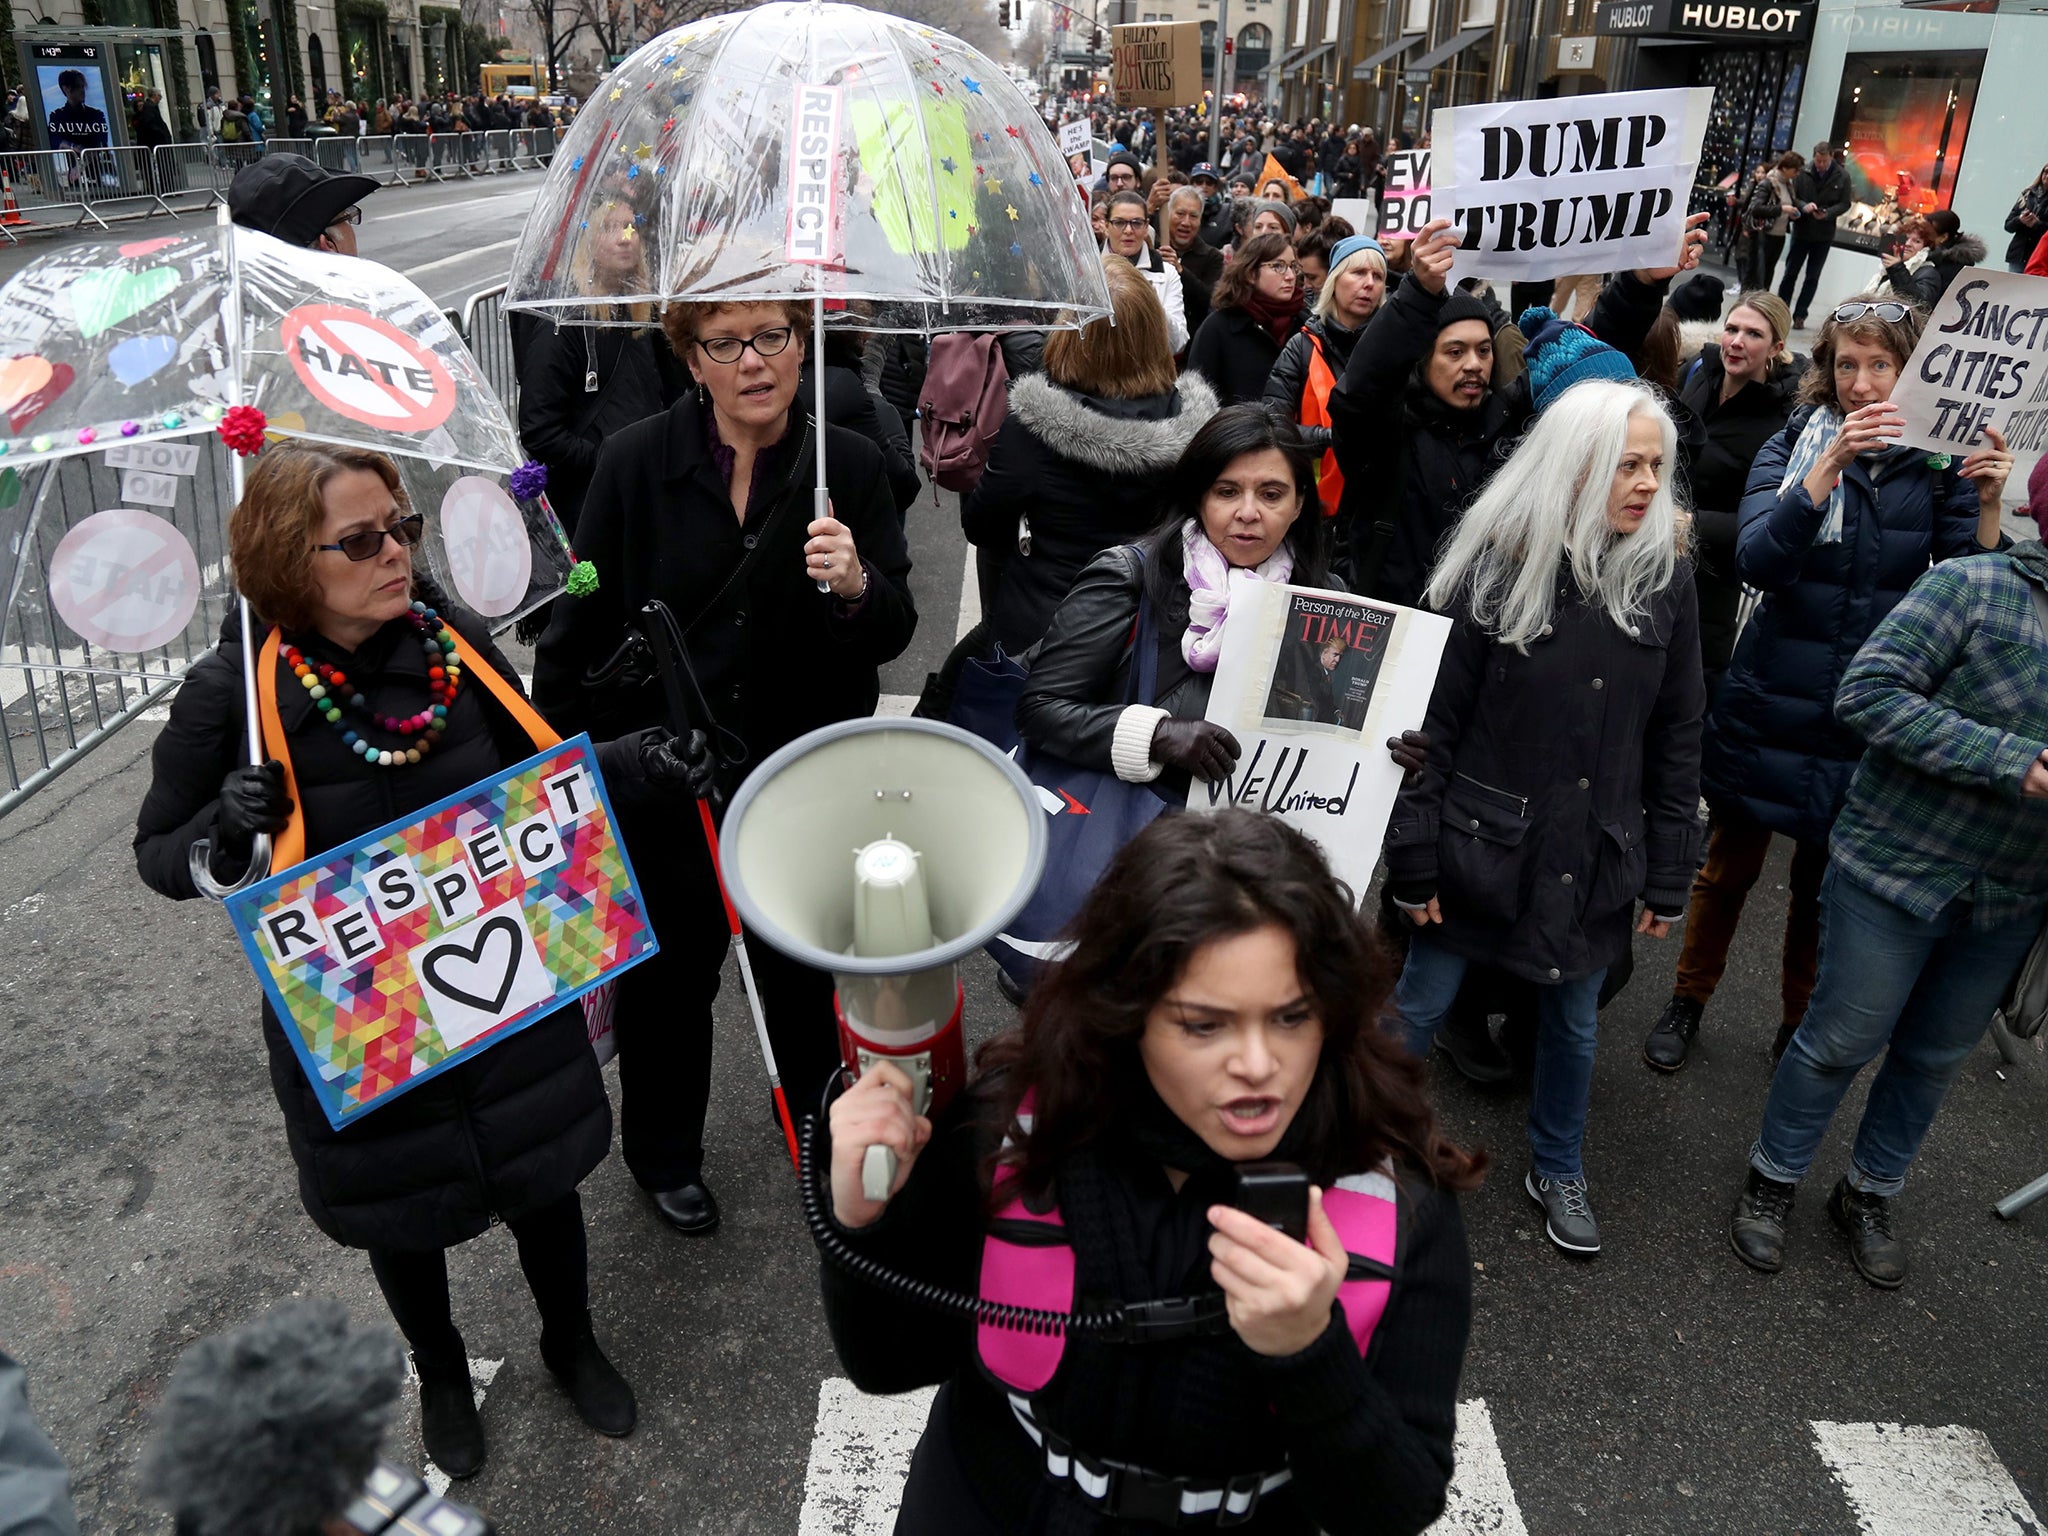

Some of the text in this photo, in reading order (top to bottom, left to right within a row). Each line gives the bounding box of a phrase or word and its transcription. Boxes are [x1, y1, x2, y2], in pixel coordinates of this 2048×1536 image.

[1609, 5, 1653, 29] HUBLOT
[1682, 4, 1801, 32] HUBLOT
[1137, 61, 1171, 91] VOTES
[49, 122, 109, 133] SAUVAGE
[1480, 115, 1667, 182] DUMP
[795, 92, 833, 256] RESPECT
[1454, 187, 1674, 252] TRUMP
[1939, 280, 2048, 353] SANCT
[296, 335, 439, 394] HATE
[1919, 343, 2031, 400] CITIES
[1928, 397, 1996, 447] THE
[1294, 597, 1390, 626] Person of the Year
[1300, 613, 1378, 653] TIME
[1260, 747, 1360, 815] United
[266, 772, 580, 960] RESPECT
